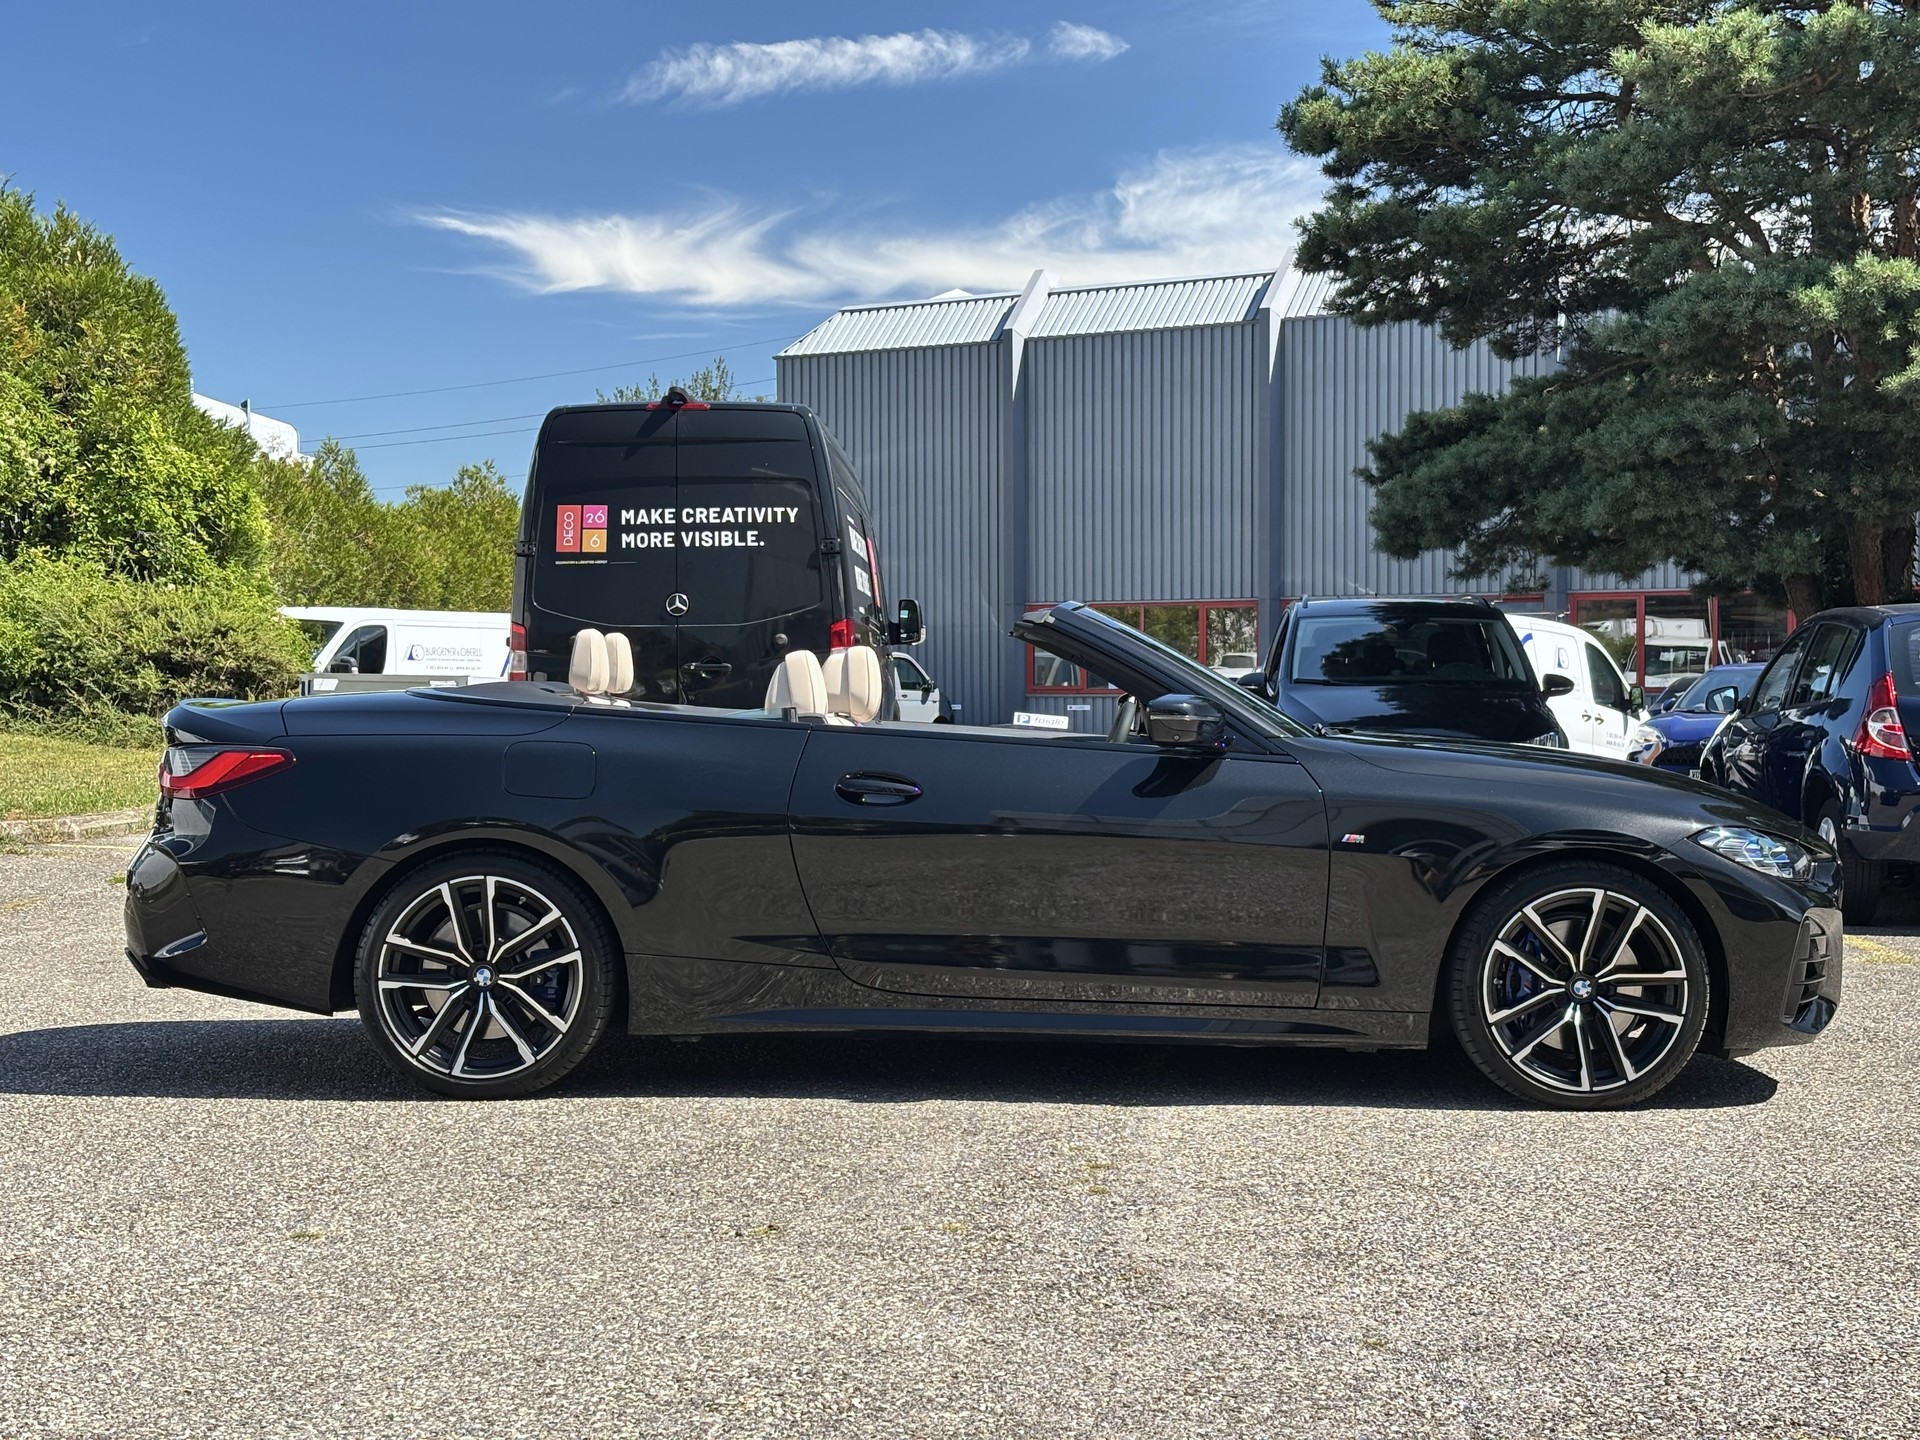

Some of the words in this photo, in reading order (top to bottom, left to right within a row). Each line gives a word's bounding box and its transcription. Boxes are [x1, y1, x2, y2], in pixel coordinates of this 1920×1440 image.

[585, 509, 605, 524] 26
[621, 508, 676, 525] MAKE
[681, 506, 799, 524] CREATIVITY
[563, 511, 575, 546] DECO
[590, 533, 600, 548] 6
[621, 531, 675, 548] MORE
[681, 530, 765, 548] VISIBLE.
